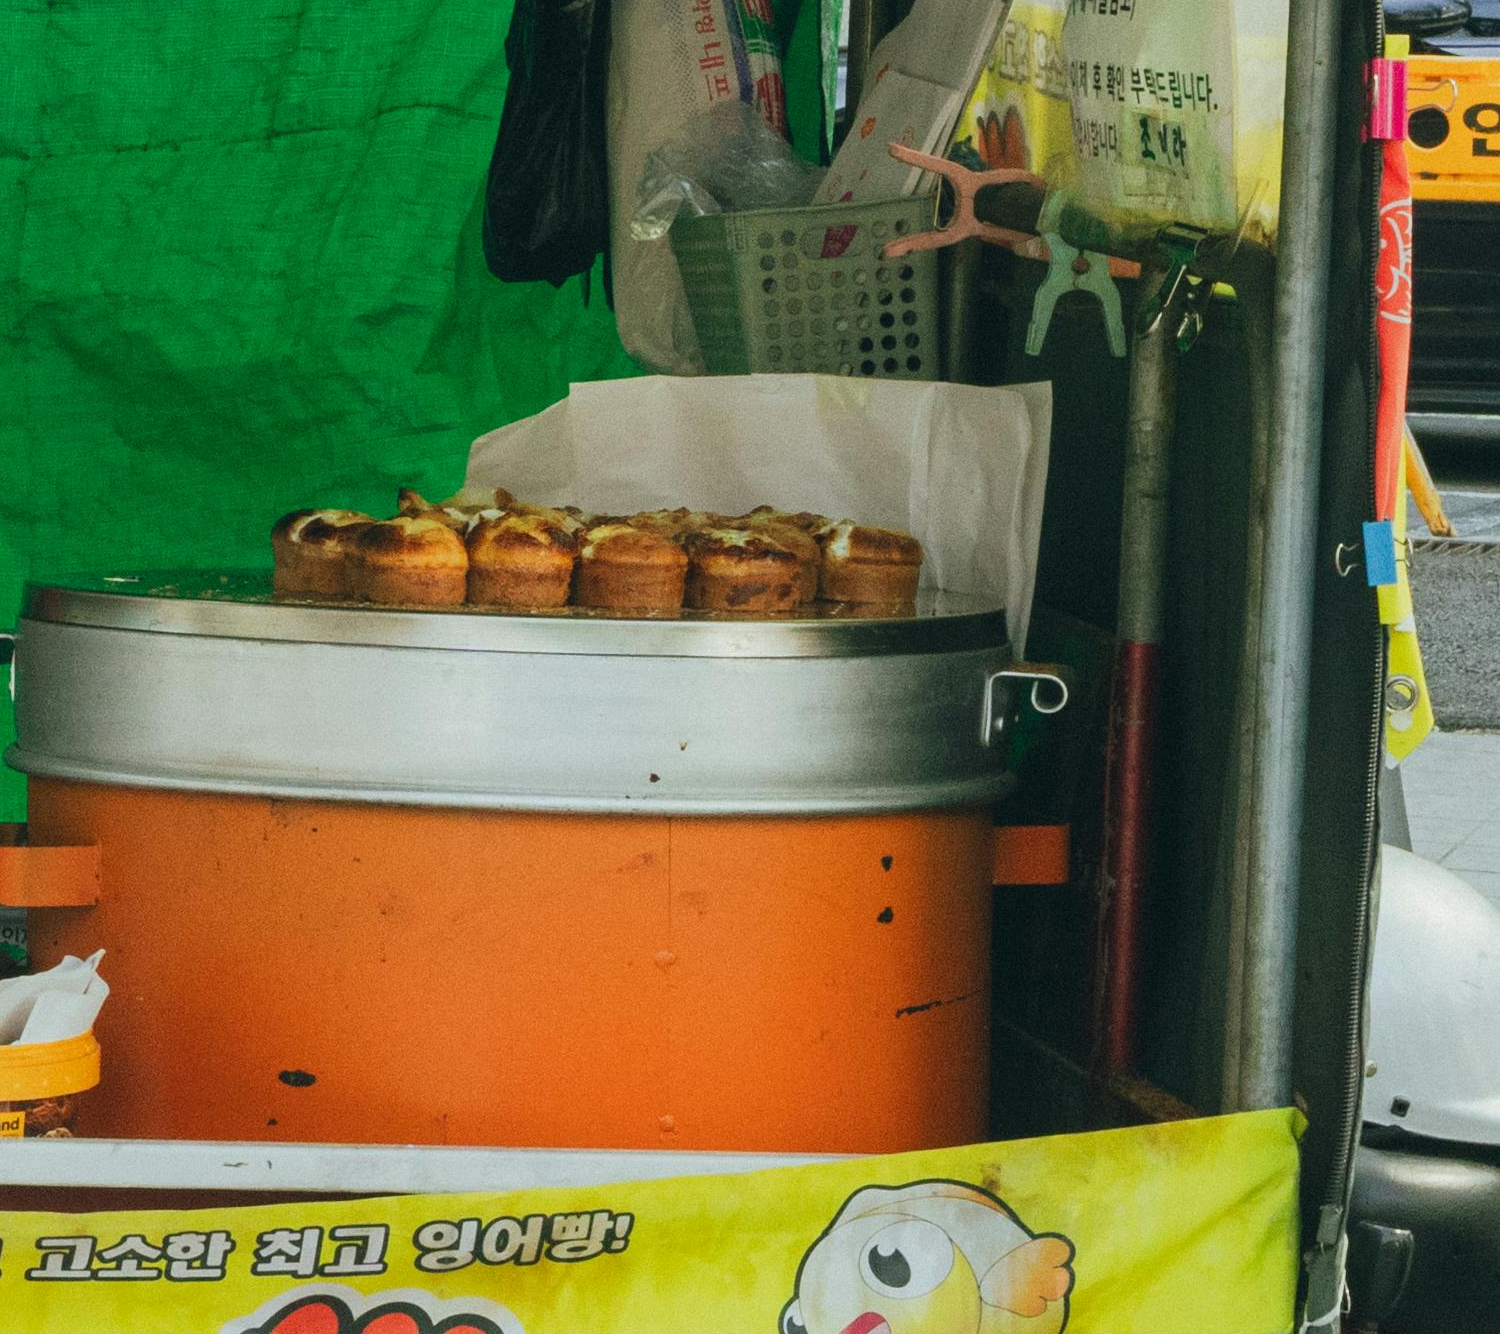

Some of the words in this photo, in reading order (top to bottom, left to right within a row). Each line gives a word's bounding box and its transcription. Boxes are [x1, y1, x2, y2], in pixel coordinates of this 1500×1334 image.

[1093, 62, 1102, 100] 후
[1131, 68, 1218, 112] 부탁드립니다.
[25, 1232, 232, 1283] 고소한
[249, 1223, 388, 1278] 최고
[413, 1209, 634, 1274] 잉어빵!
